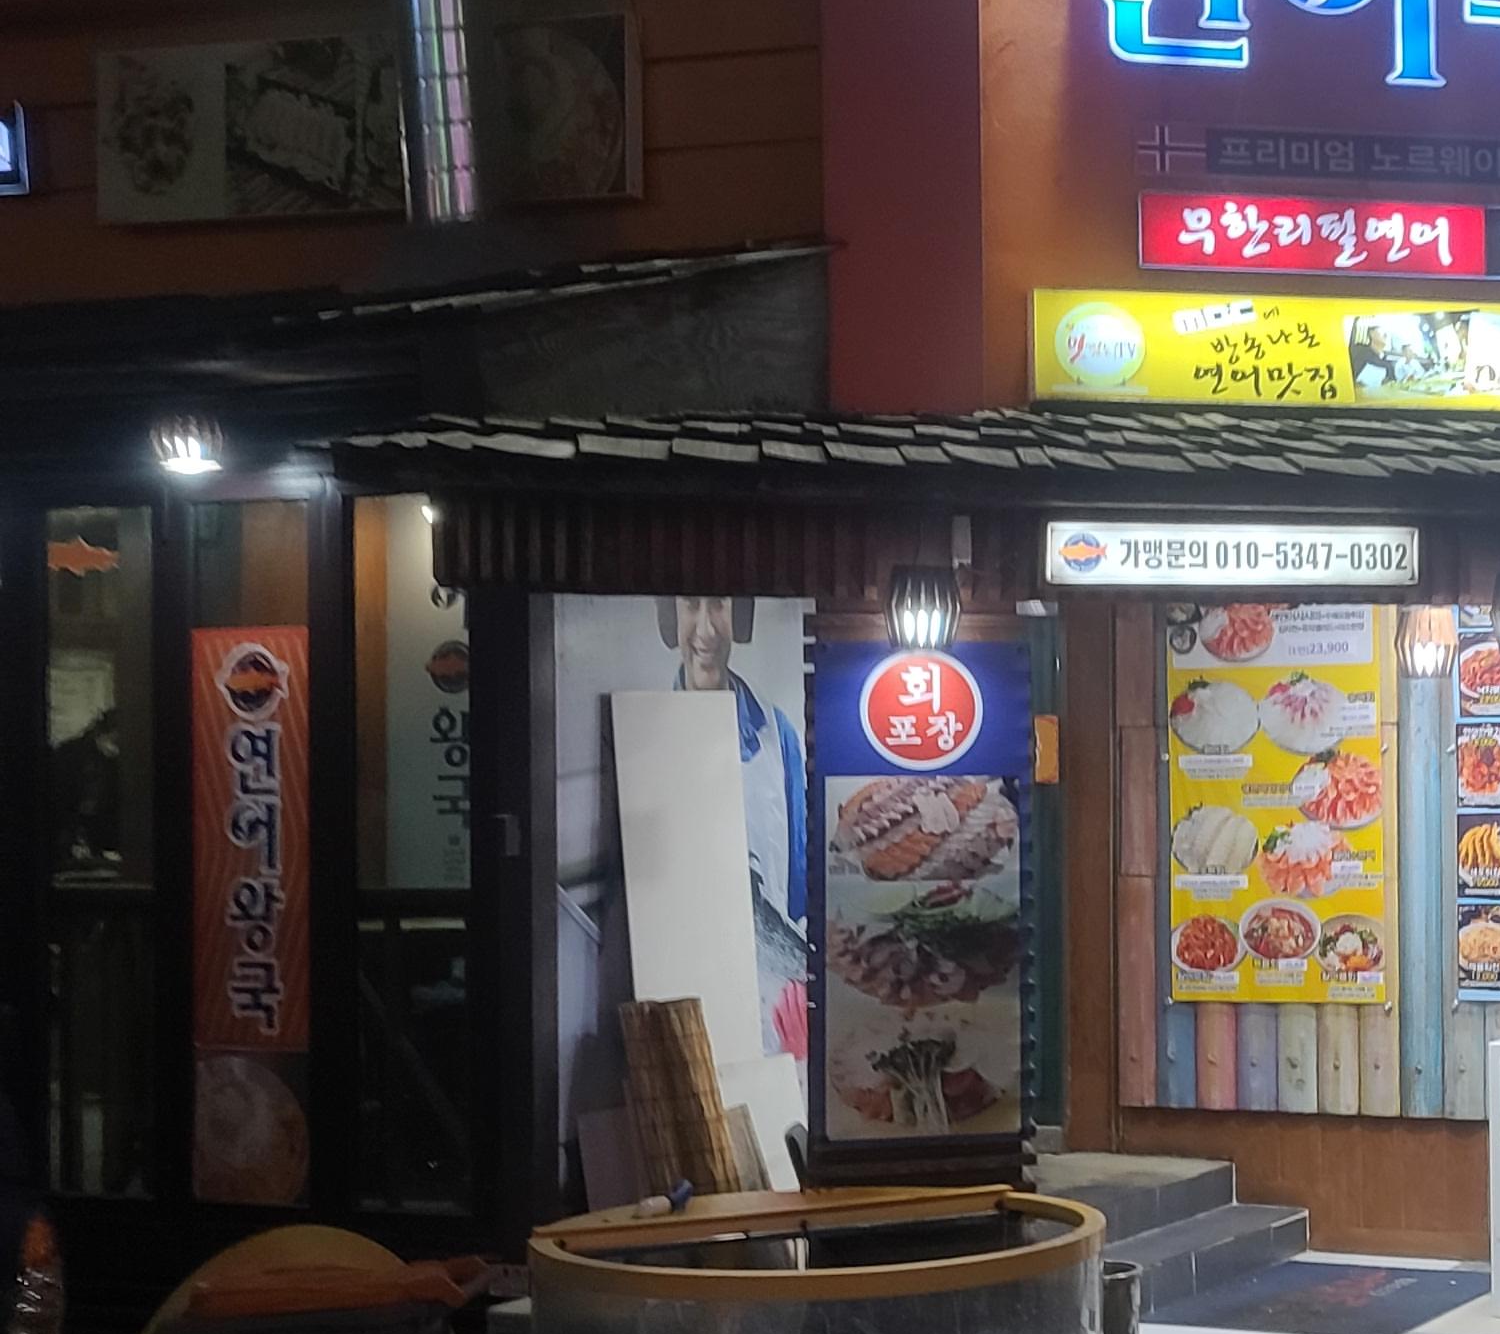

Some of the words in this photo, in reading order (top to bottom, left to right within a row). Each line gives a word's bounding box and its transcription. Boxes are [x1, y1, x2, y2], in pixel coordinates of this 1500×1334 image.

[1218, 136, 1357, 175] 프리미엄
[1176, 200, 1453, 267] 무한리필연어
[1119, 538, 1209, 569] 가맹문의
[1215, 539, 1408, 571] 010-5347-0302
[898, 662, 944, 714] 회
[885, 712, 963, 750] 포장
